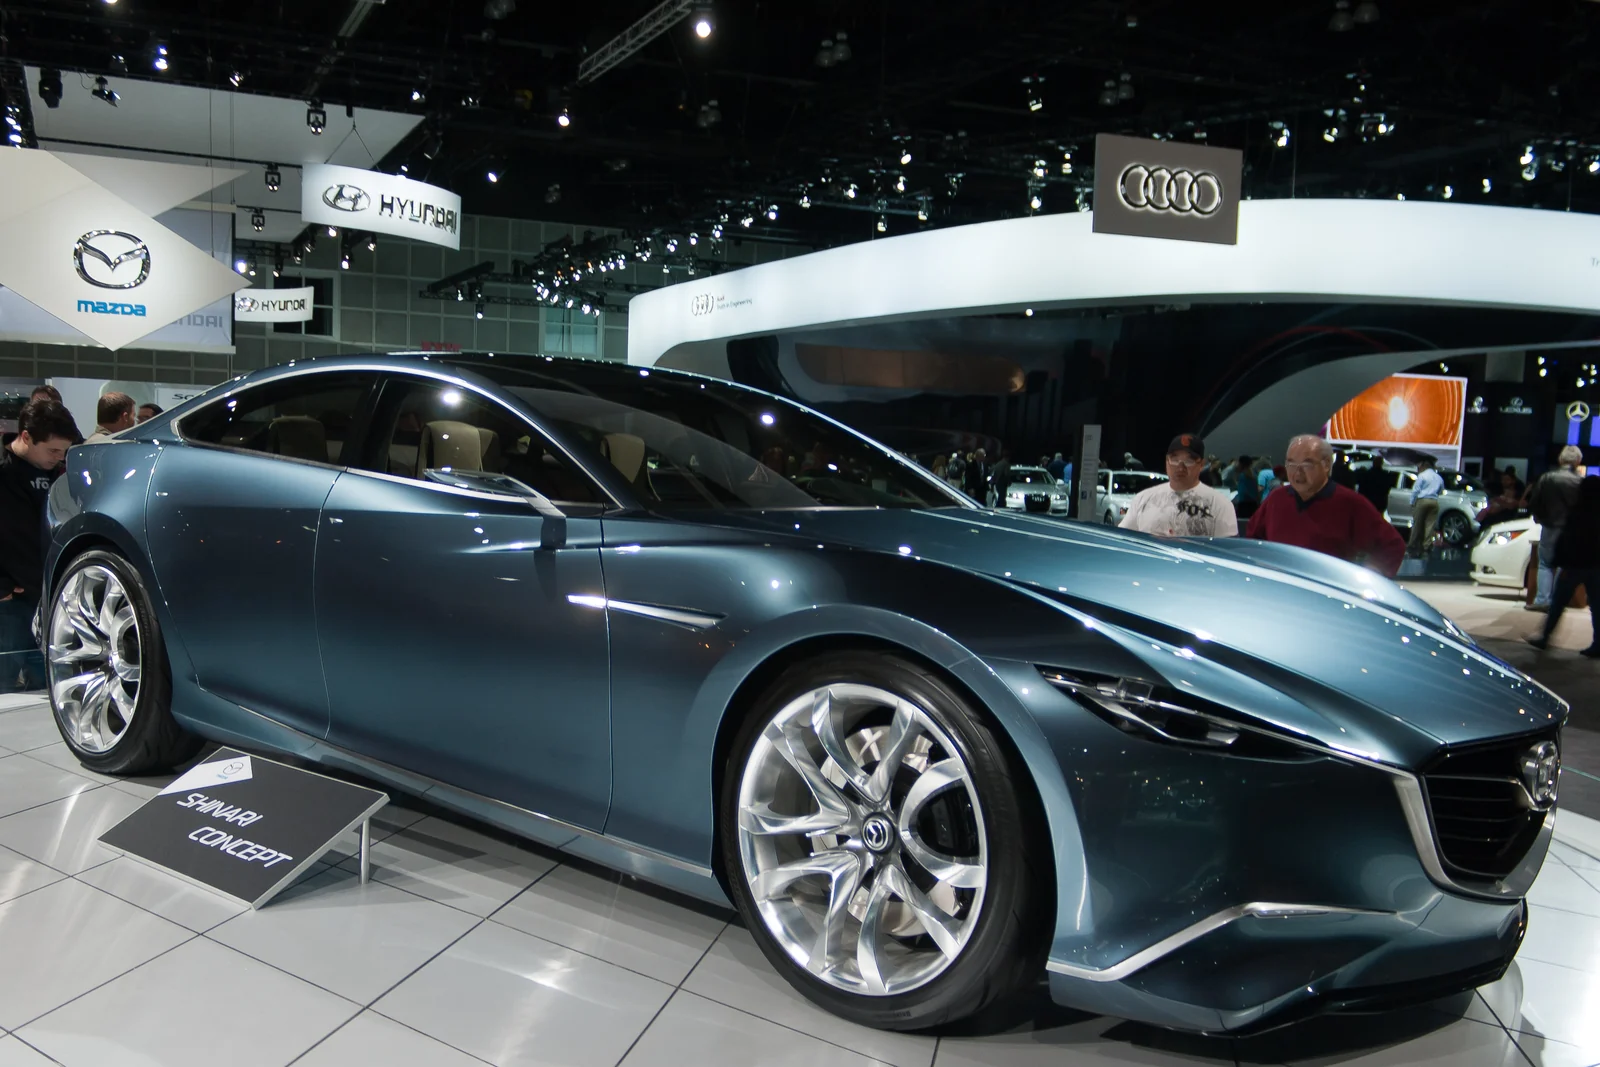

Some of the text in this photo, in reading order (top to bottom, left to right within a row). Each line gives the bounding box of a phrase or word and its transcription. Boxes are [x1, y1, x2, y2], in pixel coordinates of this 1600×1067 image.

[379, 194, 458, 235] HYUNDAI
[261, 297, 307, 312] HYUNDAI
[176, 792, 263, 827] SHINARI
[188, 826, 293, 868] CONCEPT
